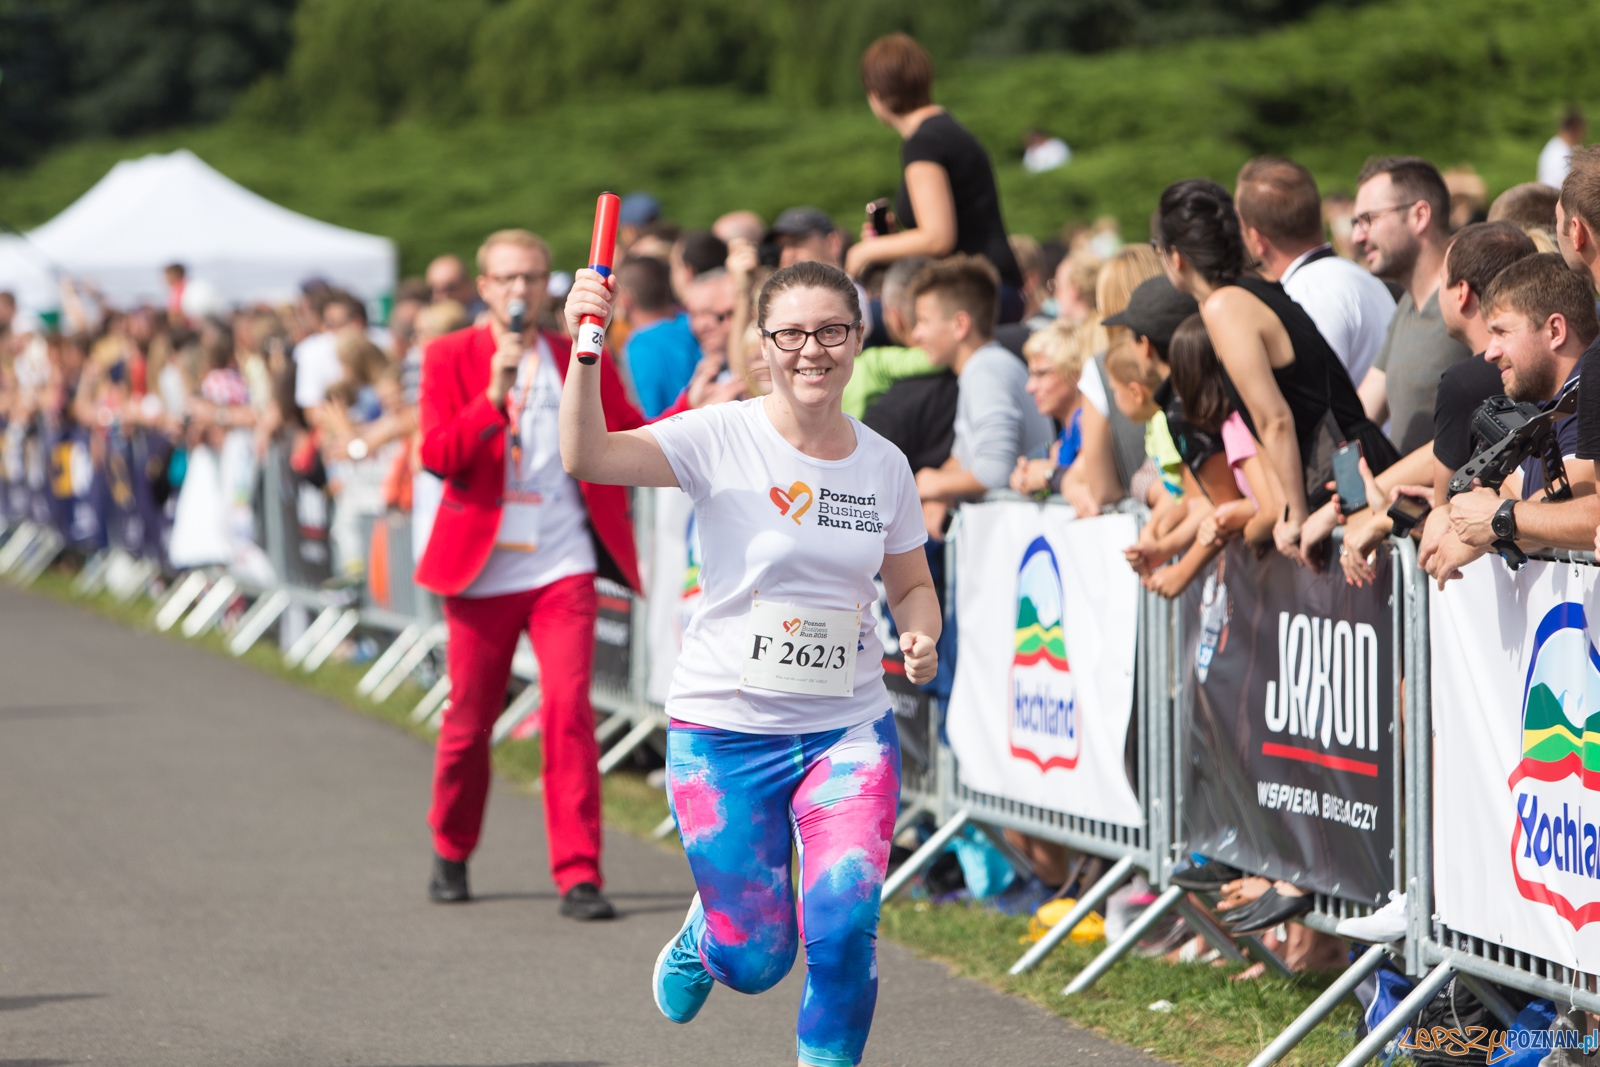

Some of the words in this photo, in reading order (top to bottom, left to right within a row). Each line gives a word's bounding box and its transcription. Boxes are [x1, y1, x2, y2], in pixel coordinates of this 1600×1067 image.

[819, 488, 876, 506] Poznań
[817, 515, 852, 530] Run
[749, 634, 773, 661] F
[778, 641, 846, 670] 262/3
[1257, 781, 1320, 817] WSPIERA
[1517, 792, 1600, 880] Hochla
